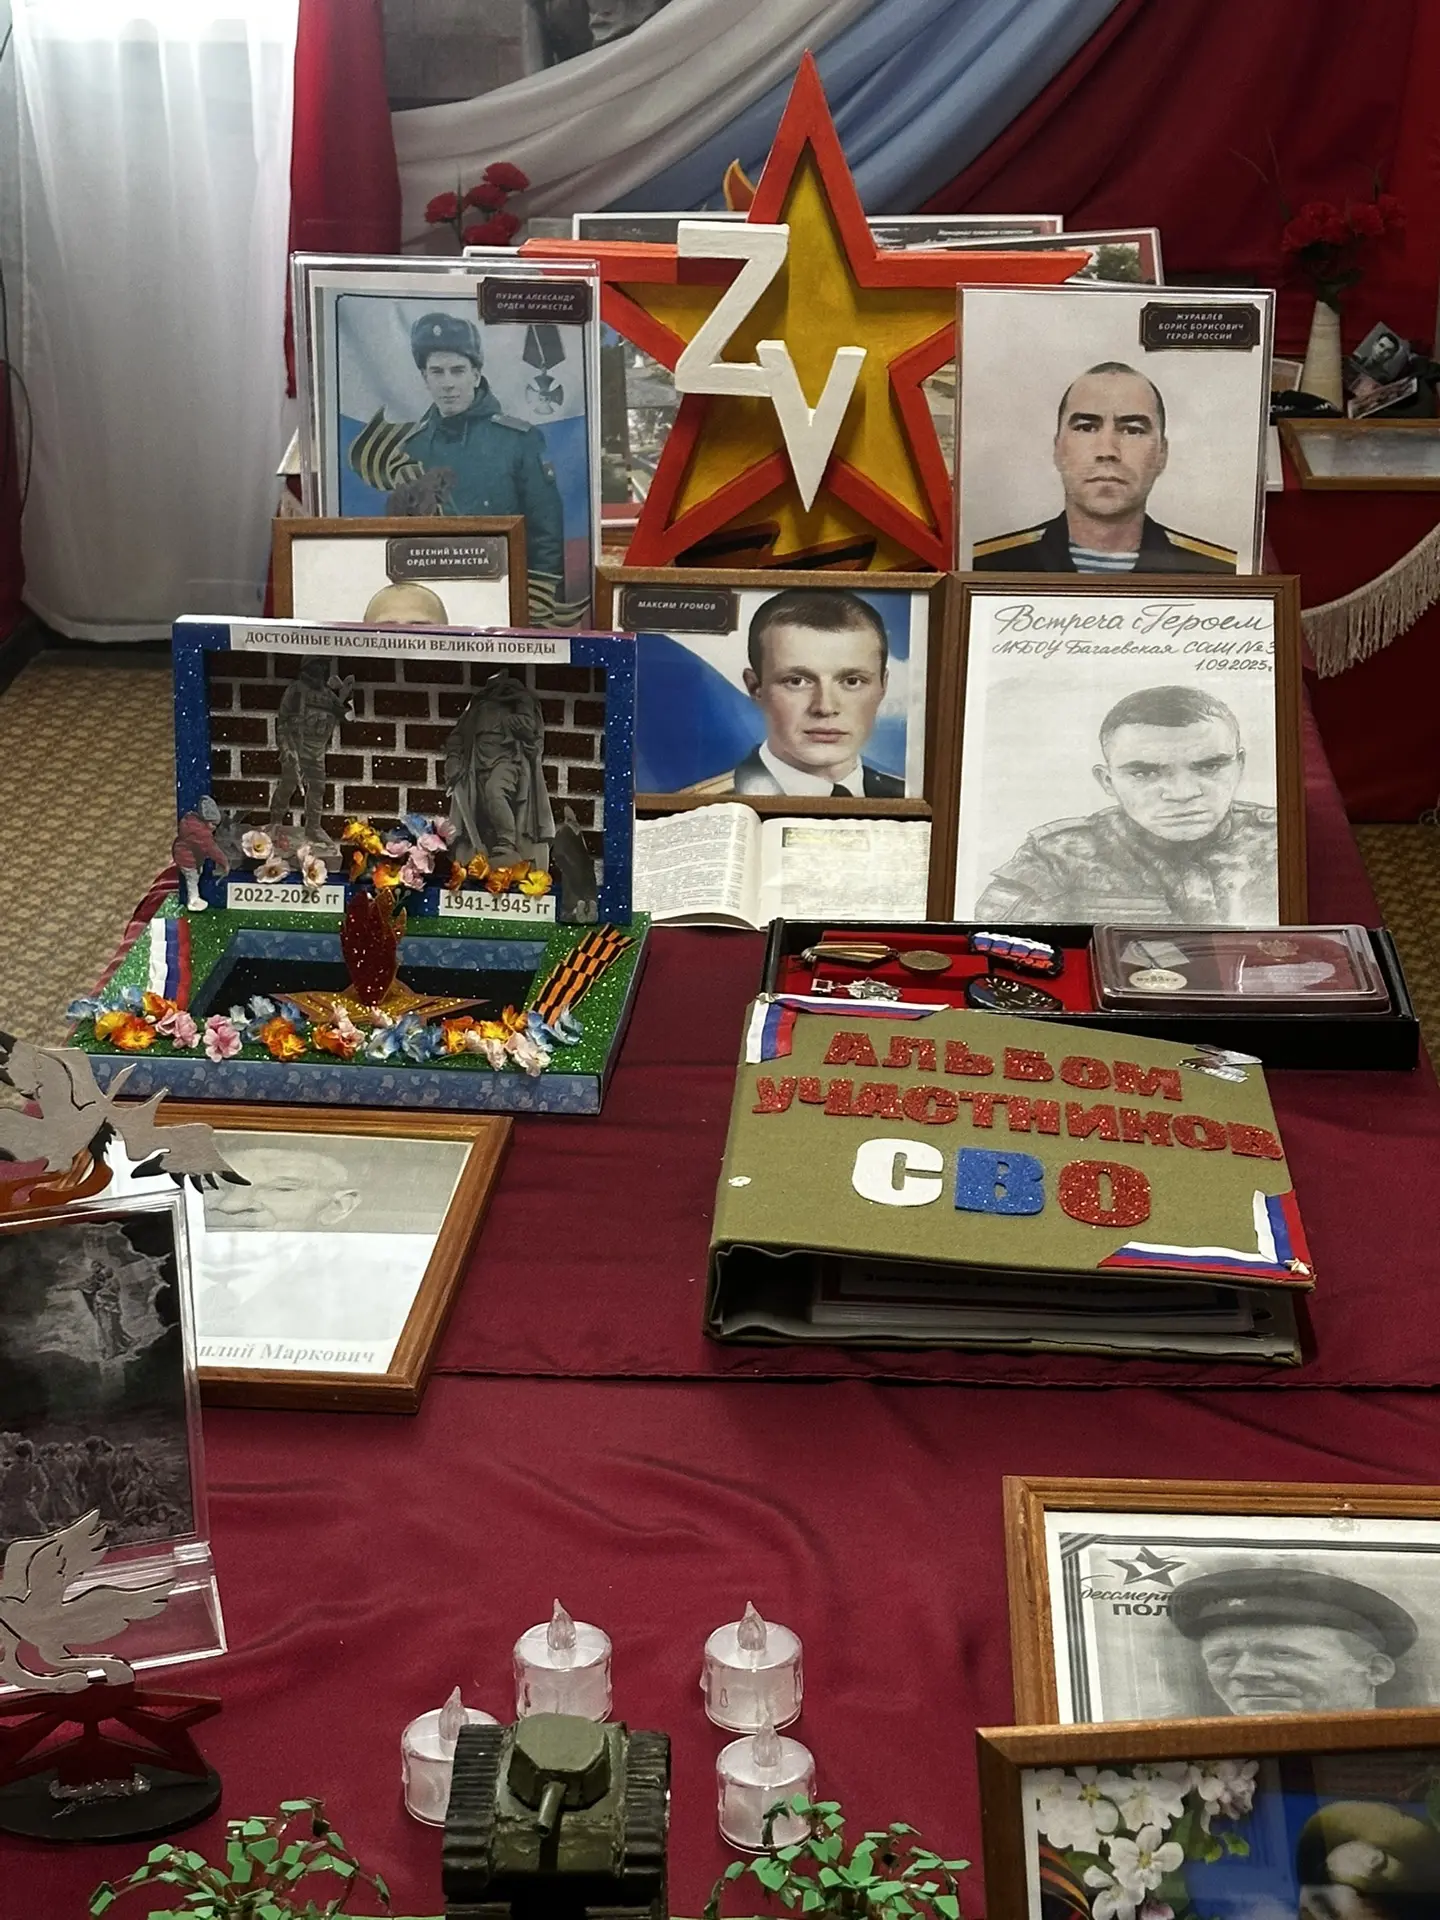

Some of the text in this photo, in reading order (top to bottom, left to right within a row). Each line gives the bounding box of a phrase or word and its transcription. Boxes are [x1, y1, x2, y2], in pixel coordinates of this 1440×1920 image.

[497, 302, 574, 311] ОРДЕН МУЖЕСТВА
[525, 293, 576, 302] АЛЕКСАНДР
[1158, 322, 1244, 331] БОРИС БОРИСОВИЧ
[1166, 332, 1232, 341] ГЕРОЙ РОССИИ
[410, 547, 486, 556] ЕВГЕНИЙ БЕХТЕР
[406, 557, 490, 567] ОРДЕН МУЖЕСТВА
[638, 600, 716, 611] МАКСИМ ГРОМОВ
[994, 604, 1122, 636] Встреча
[1140, 603, 1272, 638] Героем
[244, 630, 556, 655] ДОСТОЙНЫЕ НАСЛЕДНИКИ ВЕЛИКОЙ ПОБЕДЫ
[991, 640, 1064, 660] МБОУ
[234, 887, 340, 905] 2022-2026 гг
[443, 895, 551, 916] 1941-1945 гг
[822, 1031, 1184, 1101] АЛЬБОМ
[751, 1075, 1285, 1160] УЧАСТНИКОВ
[851, 1137, 1153, 1228] СВО
[199, 1344, 375, 1364] илий Маркович
[1112, 1603, 1173, 1617] ПОЛ
